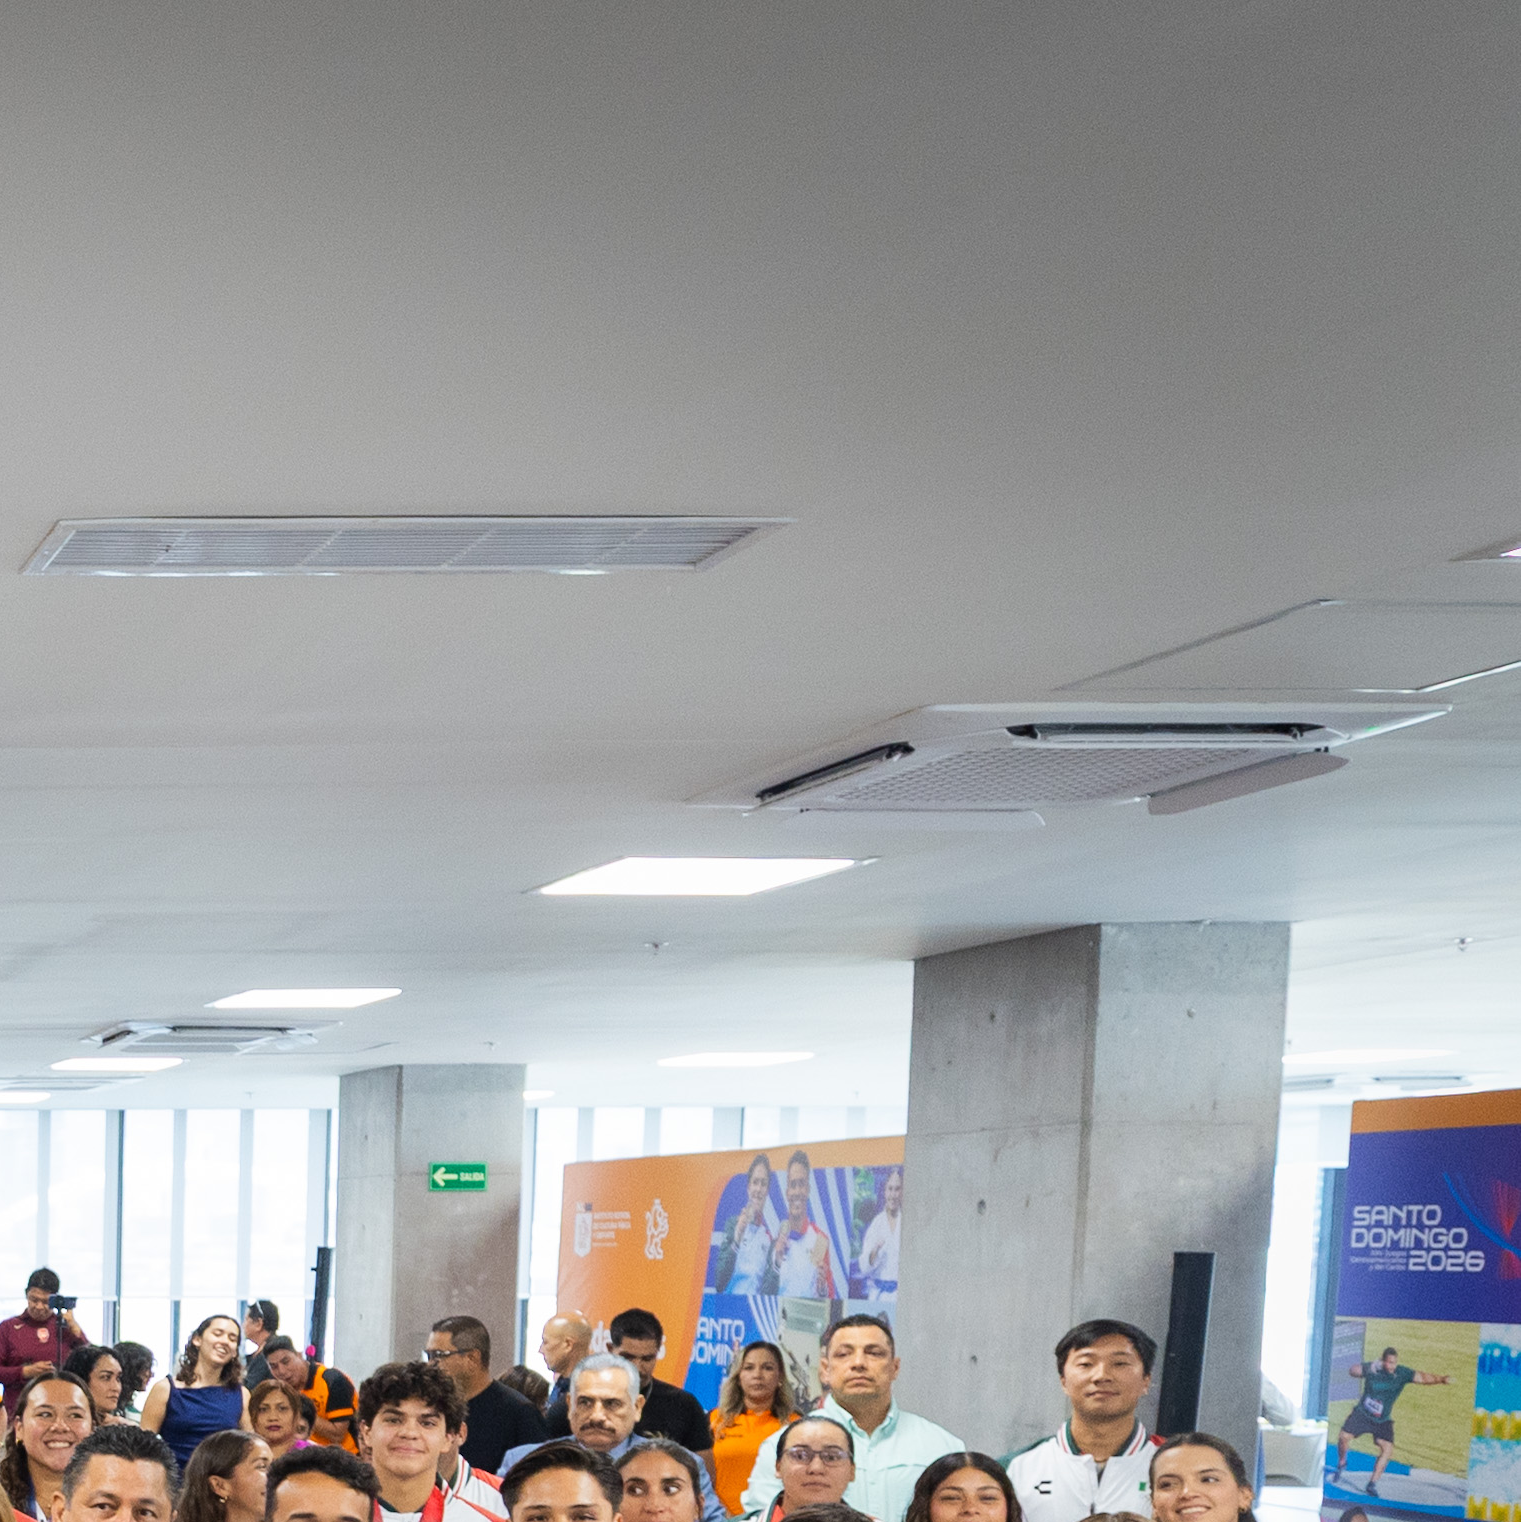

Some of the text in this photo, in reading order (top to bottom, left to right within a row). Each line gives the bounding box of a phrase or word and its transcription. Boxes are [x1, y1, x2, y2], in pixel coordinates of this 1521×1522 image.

[460, 1171, 485, 1182] SALIDA
[1352, 1205, 1442, 1226] SANTO
[1350, 1228, 1469, 1249] DOMINGO
[1408, 1250, 1485, 1272] 2026
